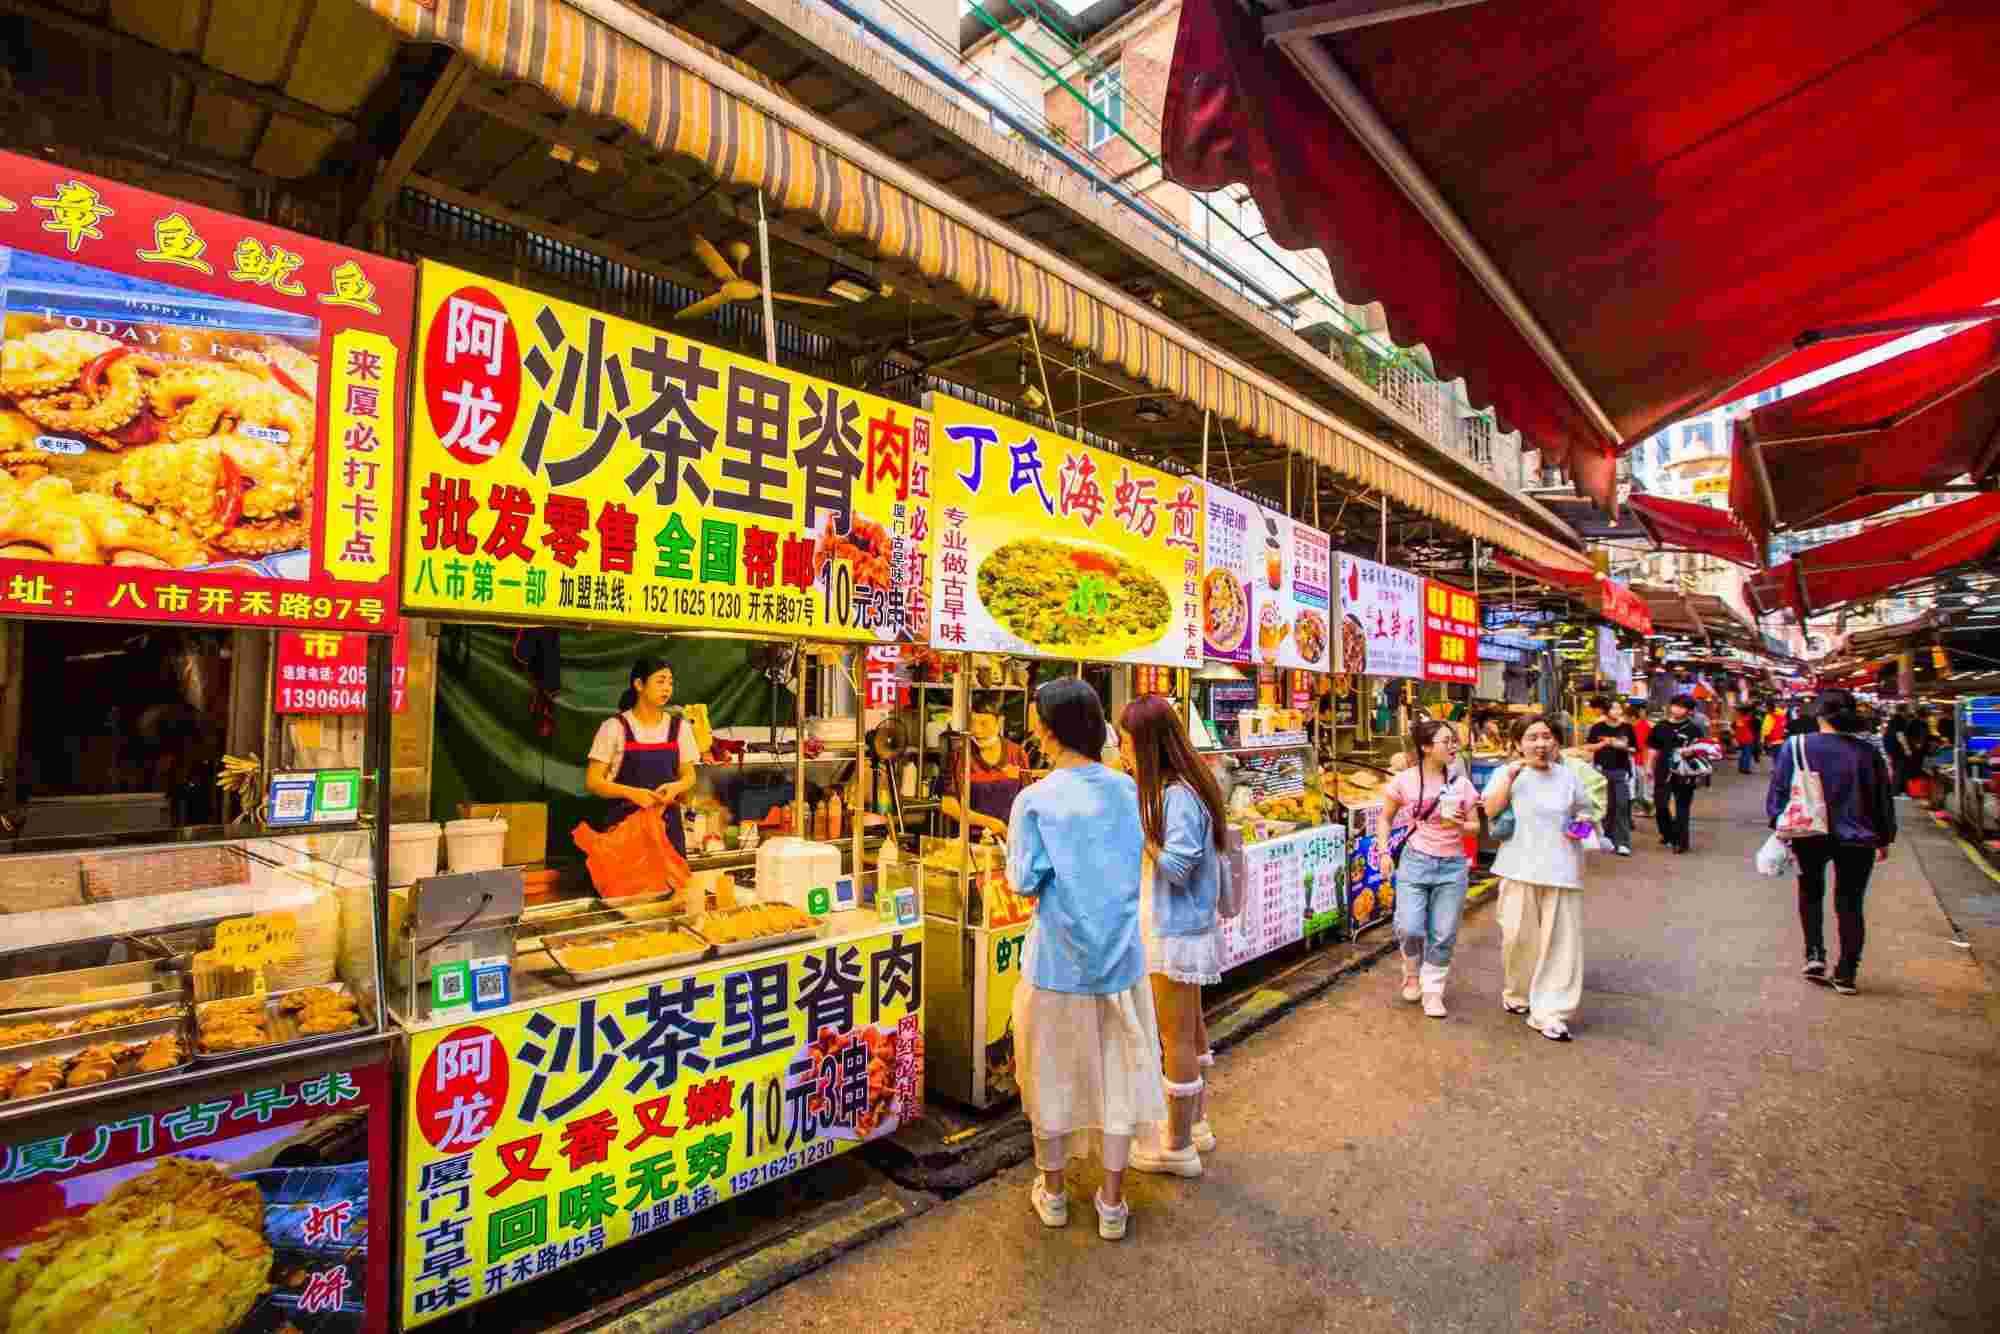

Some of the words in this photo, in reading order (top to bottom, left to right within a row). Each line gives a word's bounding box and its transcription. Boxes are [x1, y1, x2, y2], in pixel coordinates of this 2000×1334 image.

[0, 181, 382, 315] 章鱼鱿鱼
[442, 295, 507, 457] 阿龙
[520, 304, 911, 536] 沙茶里脊肉
[339, 348, 382, 564] 来厦必打卡点
[943, 425, 1200, 553] 丁氏海蛎煎
[414, 556, 547, 608] 八市第一部
[748, 594, 814, 626] 开禾路97号
[420, 472, 639, 577] 批发零售
[940, 507, 968, 644] 专业做古早味
[434, 1033, 497, 1153] 阿龙
[514, 934, 925, 1126] 沙茶里脊肉
[487, 1076, 736, 1199] 又香又嫩
[487, 1131, 735, 1264] 回味无穷
[413, 1151, 474, 1316] 厦门古早味
[483, 1226, 608, 1297] 开禾路45号
